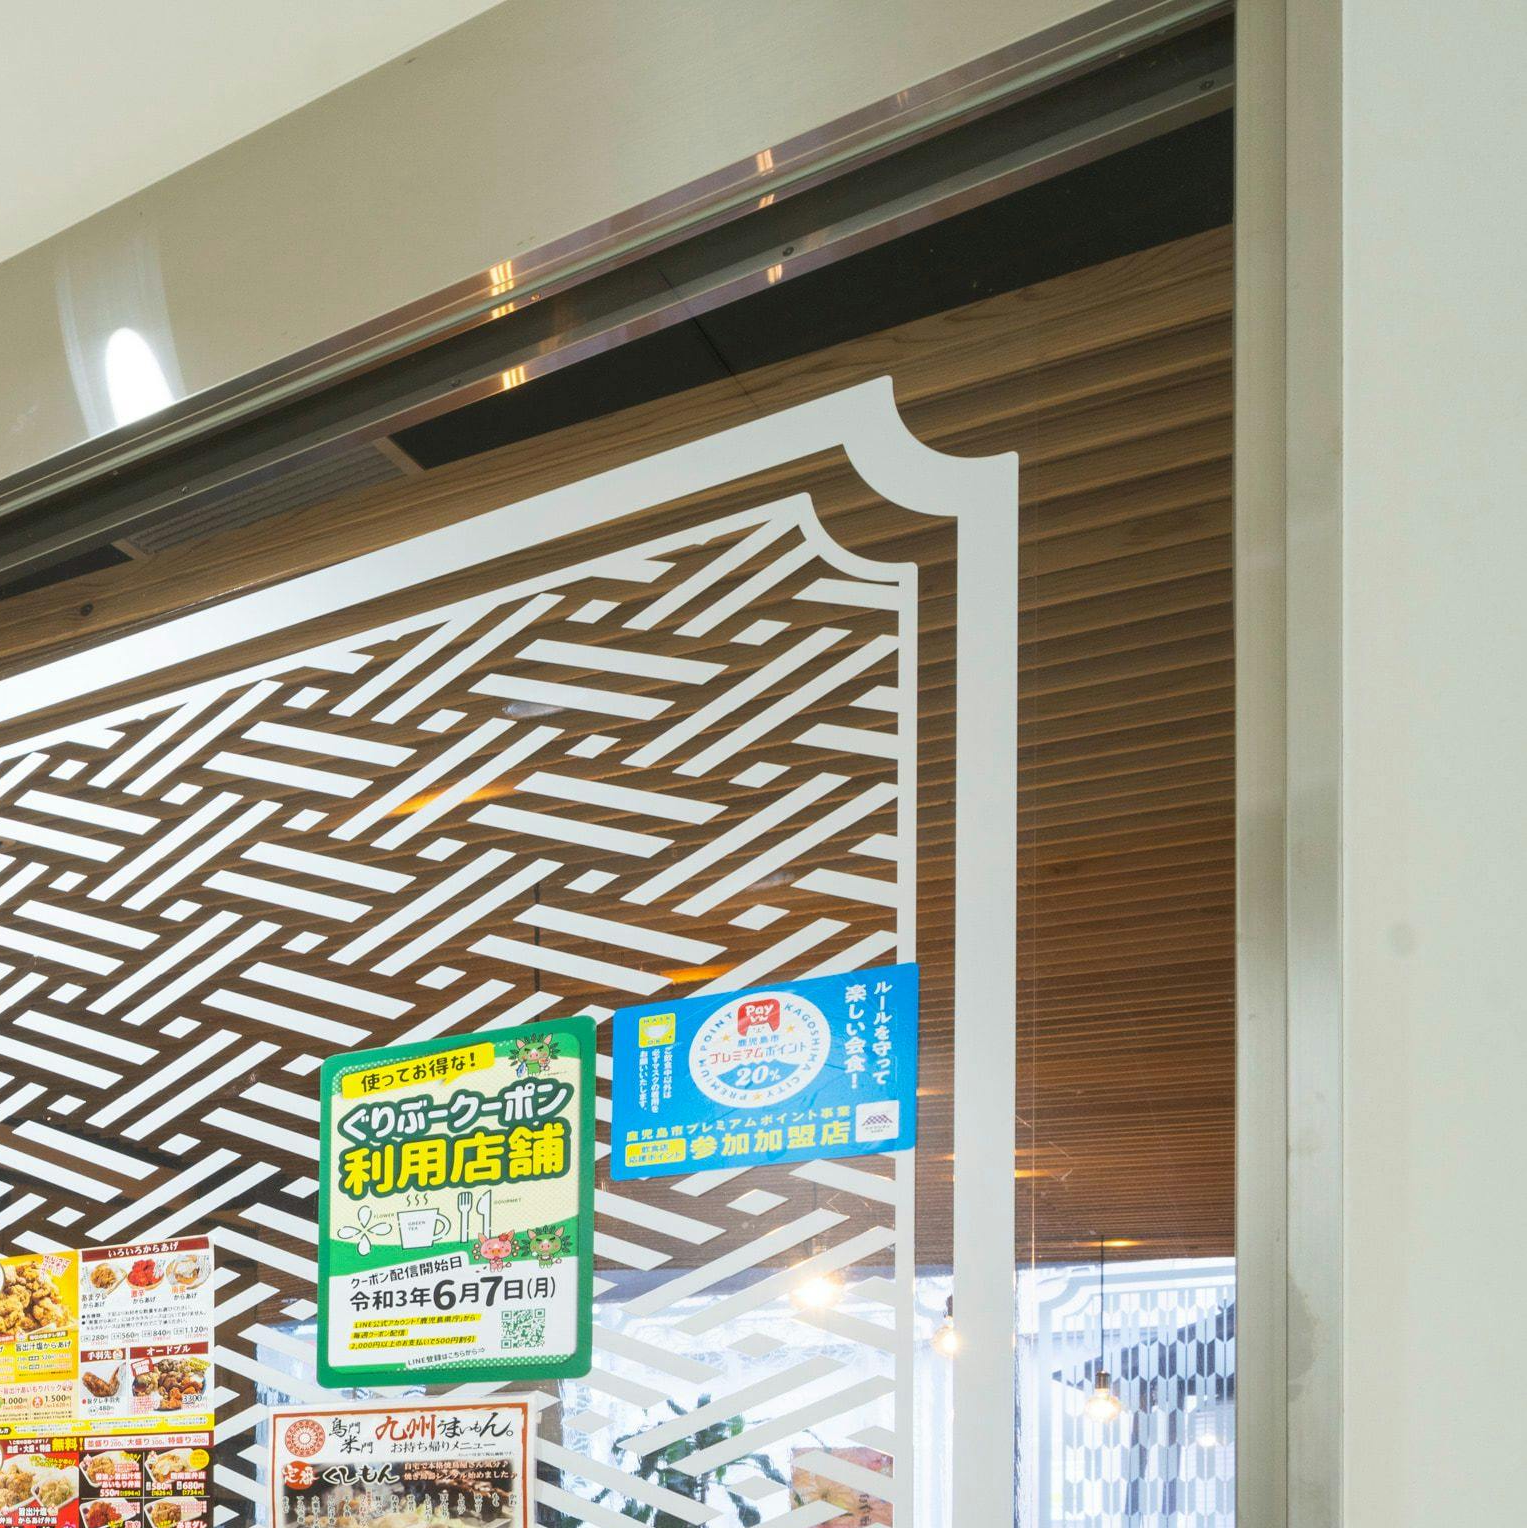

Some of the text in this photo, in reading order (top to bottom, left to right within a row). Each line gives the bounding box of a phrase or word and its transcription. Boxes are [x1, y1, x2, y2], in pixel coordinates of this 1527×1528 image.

[745, 1004, 774, 1016] Pay
[738, 1034, 779, 1048] 鹿児島市
[873, 981, 893, 1085] ルールを守って
[698, 1011, 746, 1100] PREMIUM POINT
[710, 1043, 807, 1064] プレミアムポイント
[766, 1004, 821, 1097] KAGOSHIMA CITY
[361, 1052, 476, 1093] 使ってお得な！
[735, 1065, 781, 1087] 20%
[343, 1083, 568, 1141] ぐりぶークーポン
[626, 1105, 850, 1142] 鹿児島市プレミアムポイント事業
[641, 1143, 668, 1153] 飲食店
[690, 1121, 850, 1160] 参加加盟店
[344, 1121, 565, 1196] 利用店舗
[108, 1241, 179, 1257] いろいろからあげ
[351, 1255, 463, 1289] クーポン配信開始日
[132, 1296, 156, 1304] からあげ
[349, 1275, 556, 1312] 令和3年6月7日(月)
[352, 1329, 405, 1339] 毎週クーポン配信
[146, 1345, 191, 1356] オードブル
[375, 1412, 514, 1441] 九州うまいもん。
[391, 1440, 496, 1453] お持ち帰りメニュー
[322, 1461, 400, 1485] くしもん
